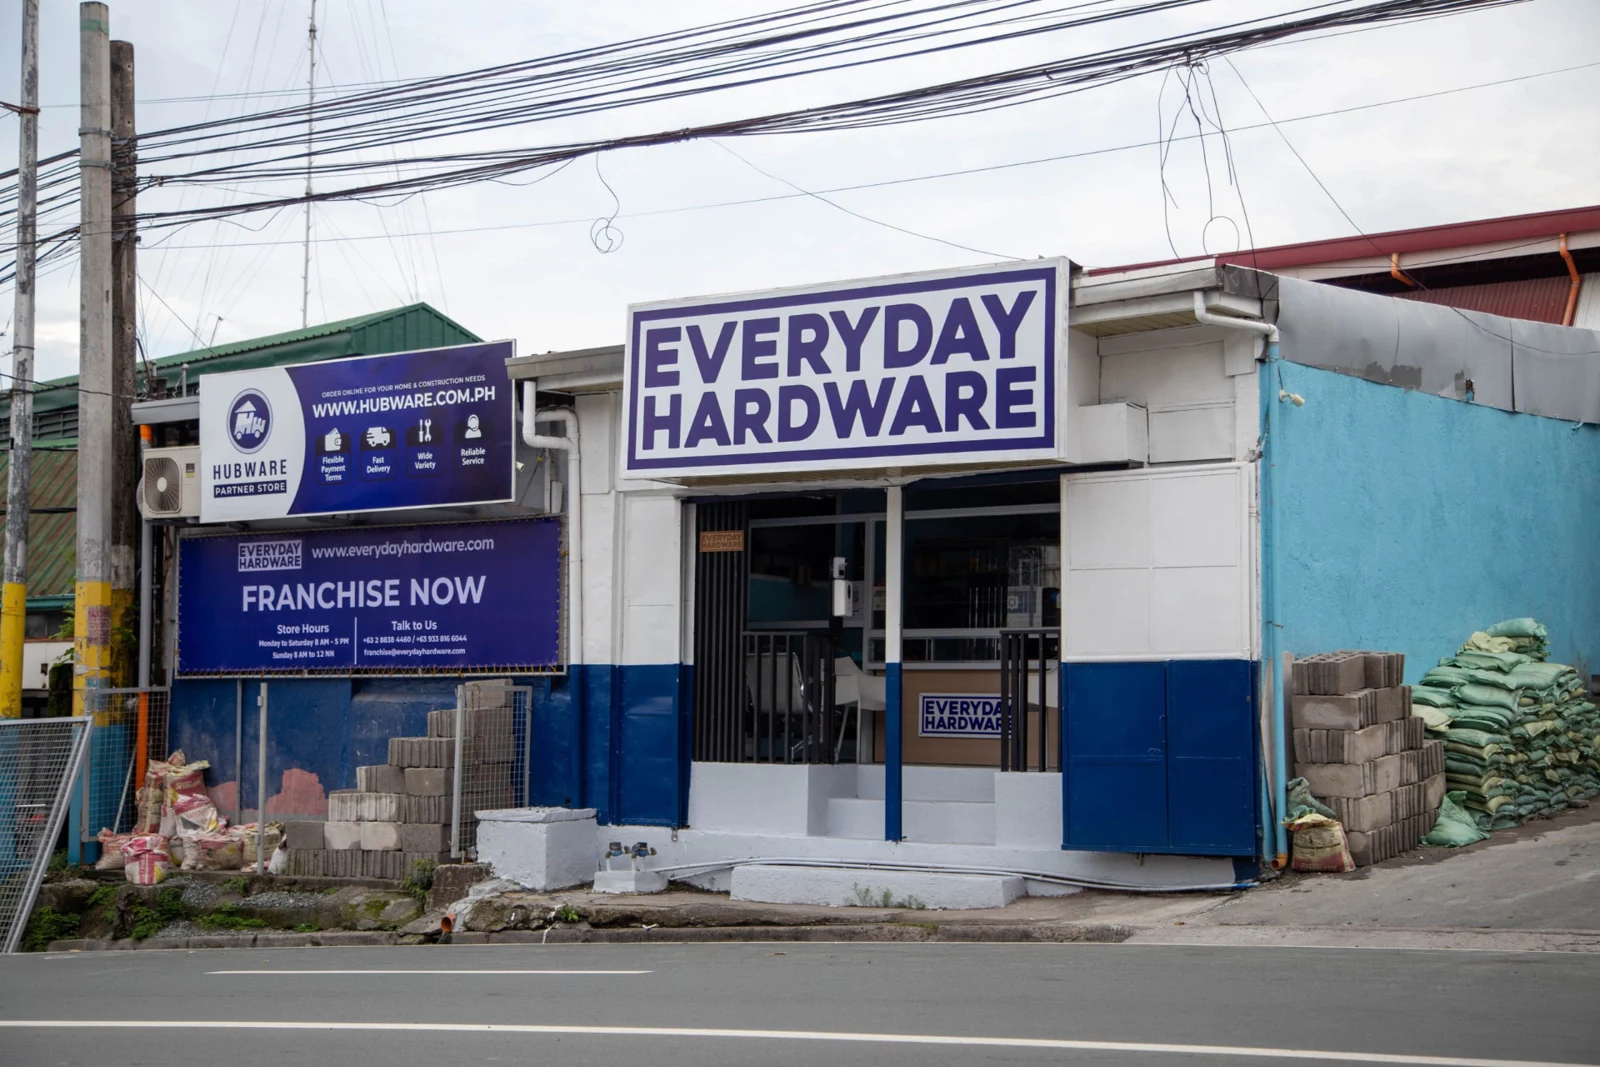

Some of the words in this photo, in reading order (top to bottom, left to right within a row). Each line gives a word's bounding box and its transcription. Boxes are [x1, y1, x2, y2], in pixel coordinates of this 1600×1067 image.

[644, 290, 1038, 389] EVERYDAY
[321, 390, 341, 398] ORDER
[342, 388, 363, 397] ONLINE
[364, 386, 376, 394] FOR
[377, 384, 393, 392] YOUR
[394, 382, 412, 390] HOME
[418, 377, 464, 388] CONSTRUCTION
[465, 374, 486, 383] NEEDS
[312, 385, 496, 418] WWW.HUBWARE.COM.PH
[642, 365, 1037, 451] HARDWARE
[417, 452, 433, 460] Wide
[461, 447, 486, 456] Reliable
[322, 455, 344, 464] Flexible
[372, 456, 384, 464] Fast
[414, 461, 436, 469] Variety
[462, 457, 484, 466] Service
[213, 459, 287, 480] HUBWARE
[321, 465, 346, 474] Payment
[366, 465, 391, 474] Delivery
[215, 484, 254, 495] PARTNER
[257, 482, 285, 492] STORE
[702, 533, 742, 541] EVERYDAY
[239, 542, 300, 557] EVERYDAY
[311, 538, 494, 558] www.everydayhardware.com
[701, 540, 742, 549] HARDWARE
[239, 555, 301, 569] HARDWARE
[242, 579, 400, 611] FRANCHISE
[410, 575, 486, 606] NOW
[276, 624, 300, 634] Store
[302, 623, 329, 633] Hours
[391, 620, 411, 631] Talk
[412, 621, 423, 630] to
[424, 620, 437, 630] Us
[258, 640, 280, 648] Monday
[281, 639, 288, 647] to
[288, 638, 313, 647] Saturday
[314, 638, 319, 646] 8
[320, 638, 329, 646] AM
[334, 637, 339, 645] 5
[339, 637, 349, 645] PM
[363, 636, 374, 644] +63
[374, 636, 379, 644] 2
[411, 635, 416, 644] /
[416, 635, 427, 643] +63
[427, 635, 439, 643] 933
[450, 634, 467, 642] 6044
[272, 651, 293, 660] Sunday
[293, 651, 298, 659] 8
[316, 650, 324, 658] 12
[363, 647, 466, 657] franchise@everydayhardware.com
[925, 700, 1011, 716] EVERYDA
[925, 716, 1011, 730] HARDWAR
